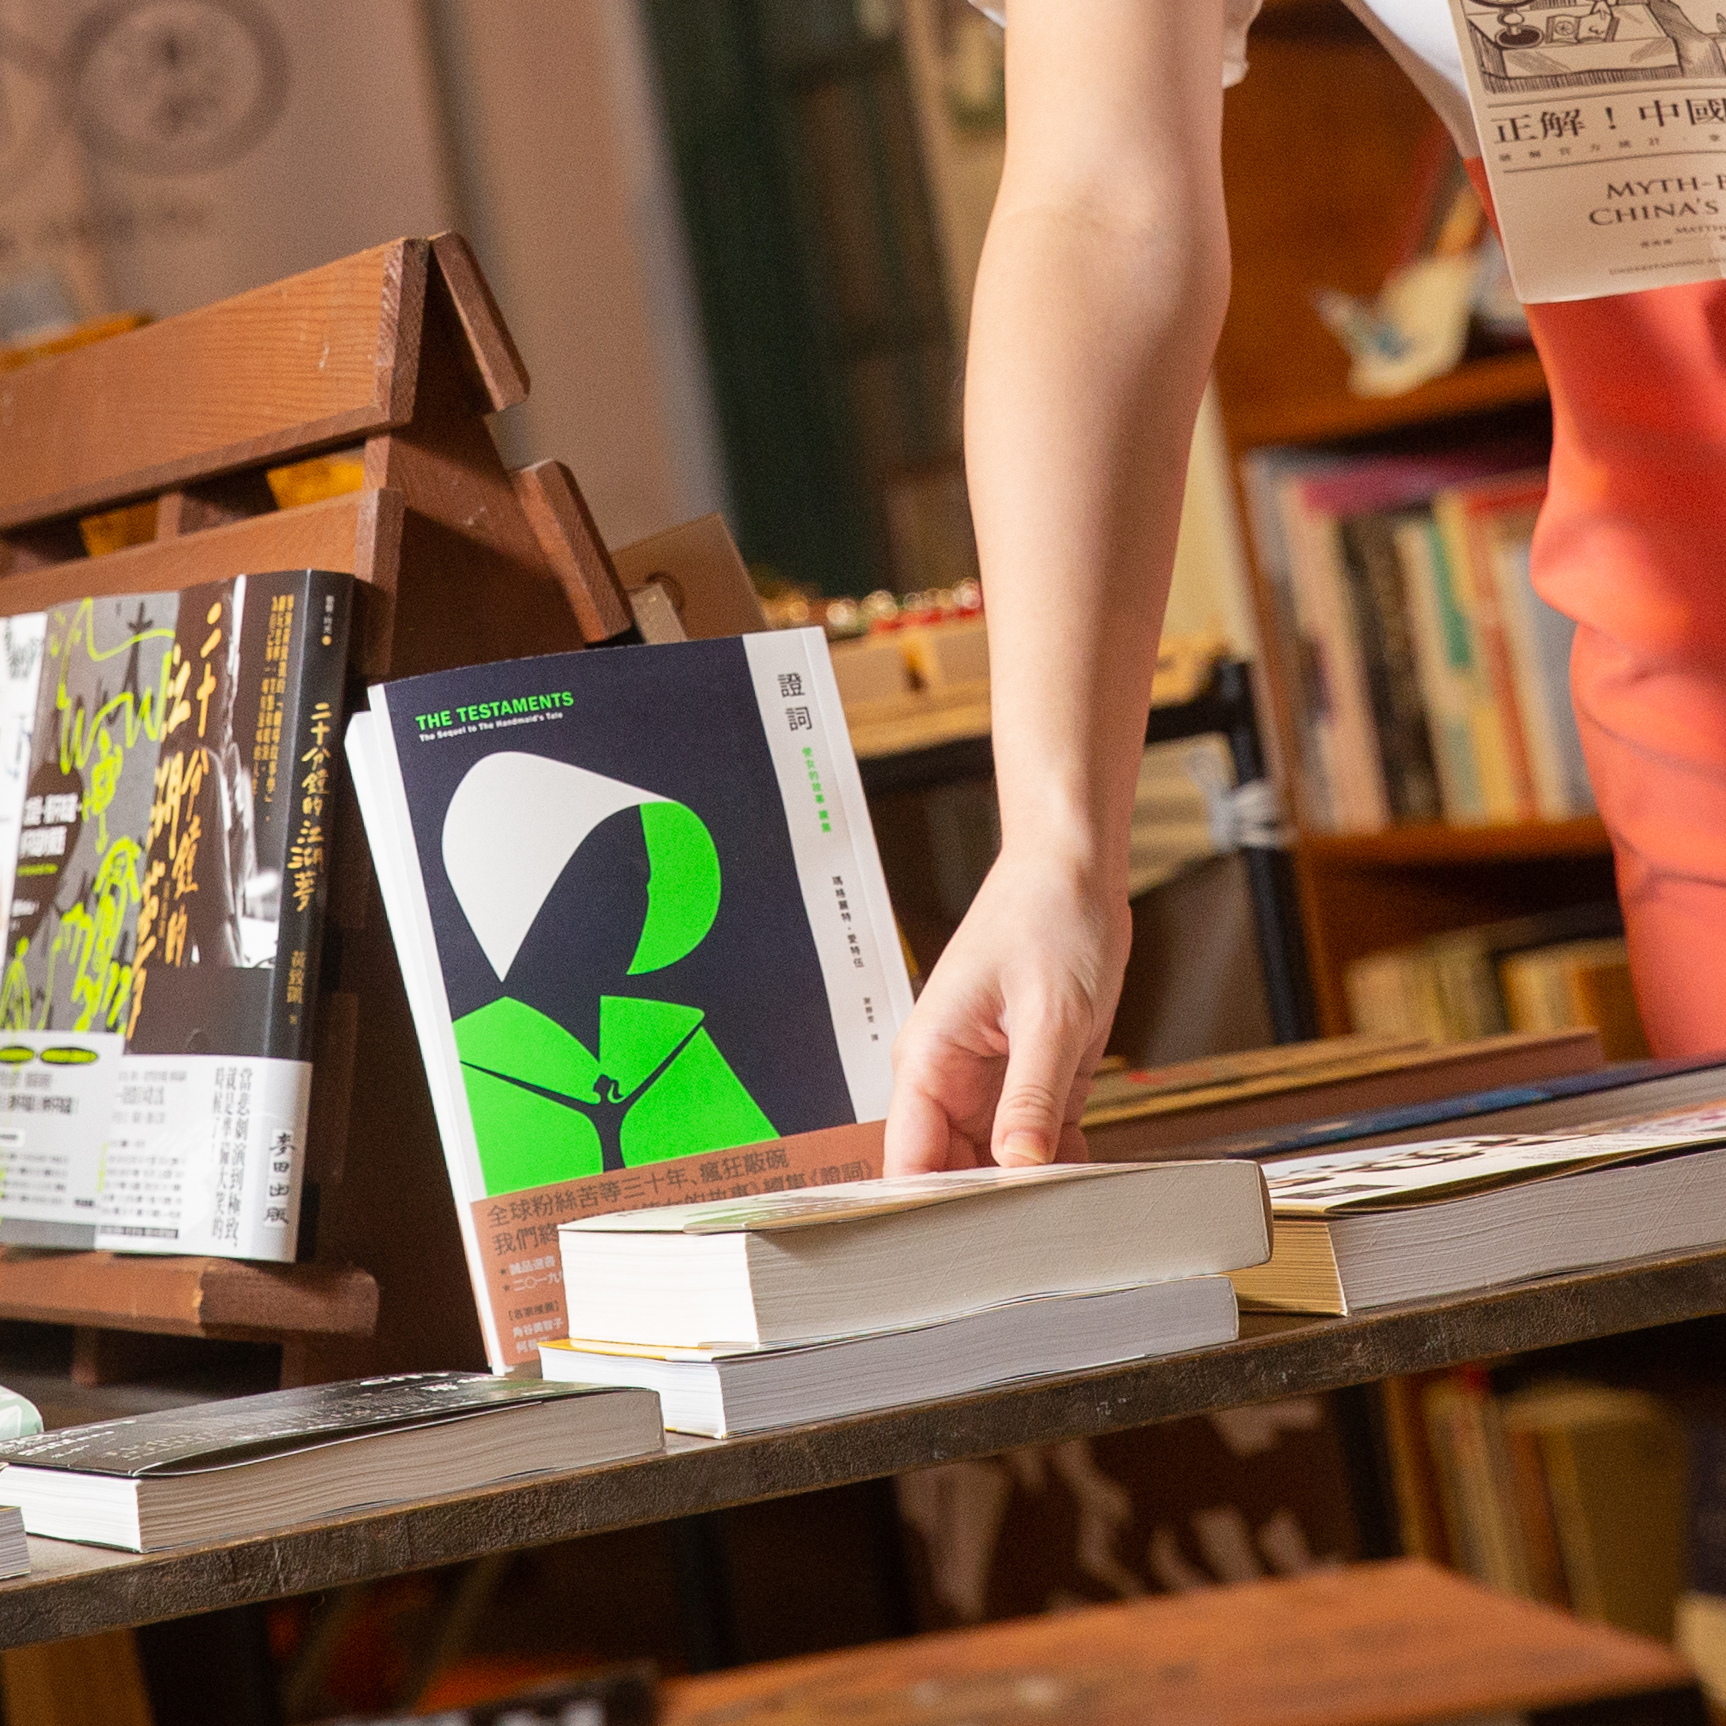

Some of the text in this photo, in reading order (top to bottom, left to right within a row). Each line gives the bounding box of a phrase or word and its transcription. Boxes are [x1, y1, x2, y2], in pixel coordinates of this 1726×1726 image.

[1589, 198, 1719, 225] CHINA'S
[415, 691, 574, 731] THE TESTAMENTS
[419, 711, 563, 742] The Sequel to The Handmaid's Tale
[777, 672, 813, 732] 證詞
[287, 702, 331, 912] 二十分鐘的江湖夢
[263, 1131, 296, 1225] 麥田出版
